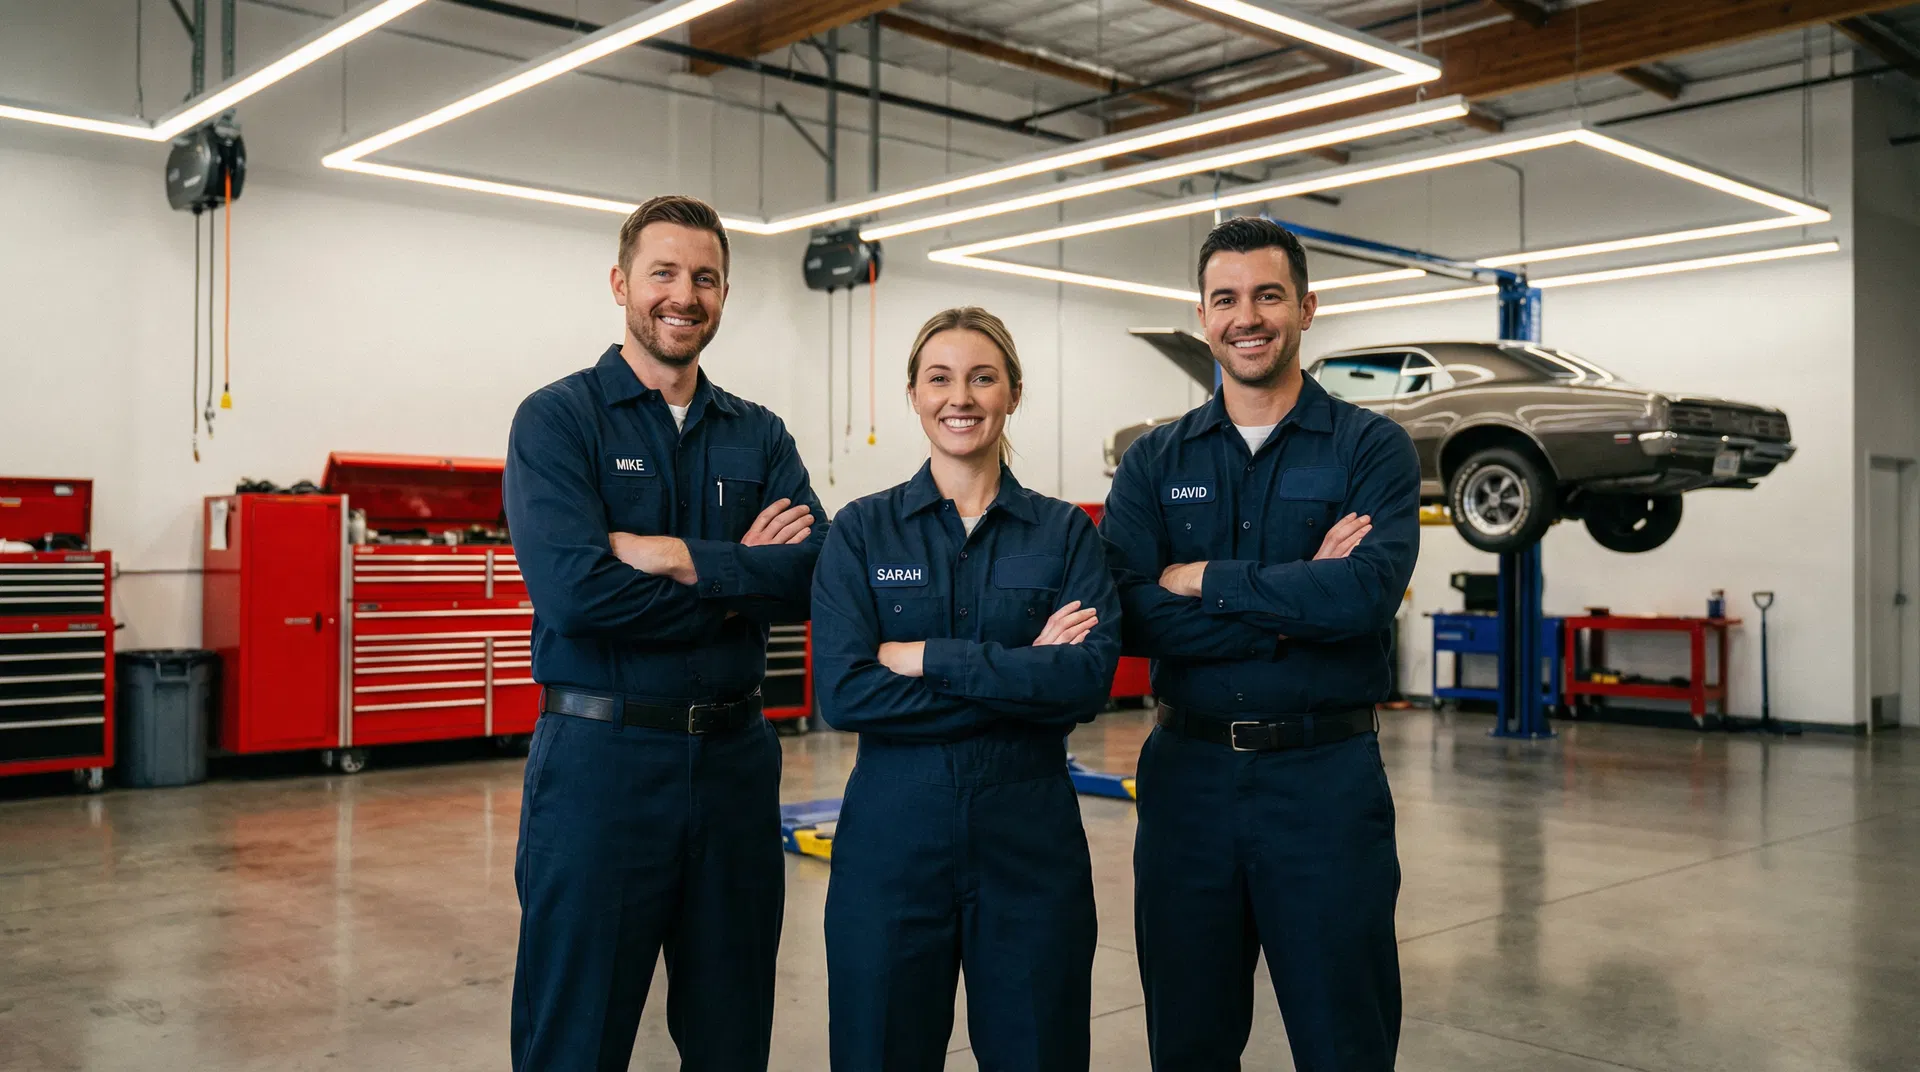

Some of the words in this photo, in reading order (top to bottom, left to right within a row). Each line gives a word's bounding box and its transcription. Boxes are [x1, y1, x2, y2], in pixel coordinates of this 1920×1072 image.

[616, 459, 645, 471] MIKE
[1171, 487, 1207, 499] DAVID
[877, 569, 921, 581] SARAH
